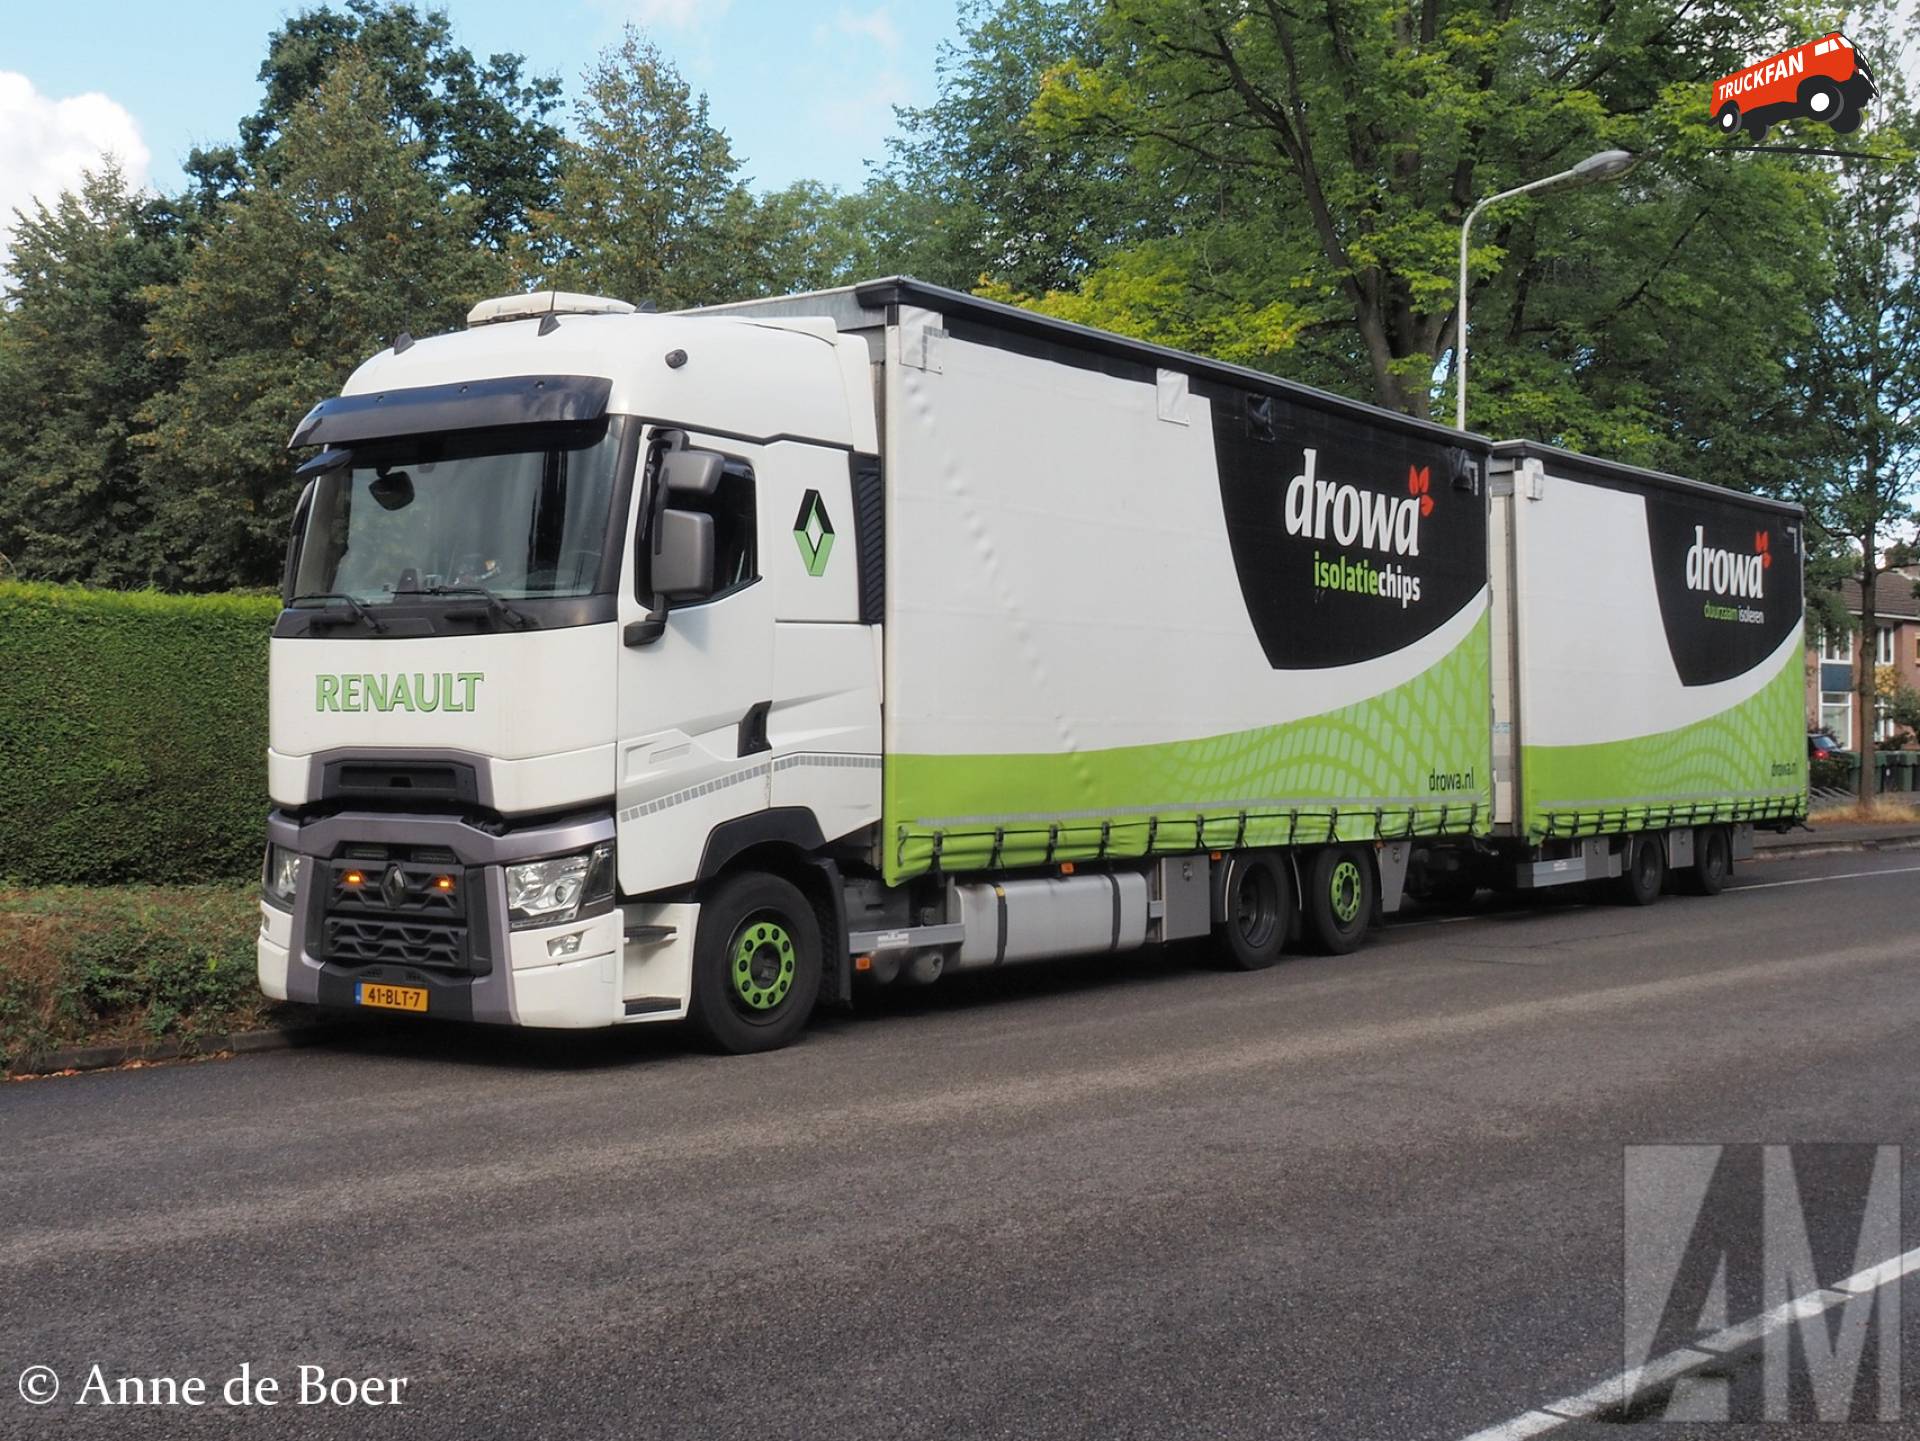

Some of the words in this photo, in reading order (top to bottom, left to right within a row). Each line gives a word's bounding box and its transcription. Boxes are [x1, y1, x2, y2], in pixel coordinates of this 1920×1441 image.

[1284, 447, 1420, 557] drowa
[1314, 550, 1421, 609] isolatiechips
[1686, 525, 1764, 599] drowa
[315, 672, 485, 713] RENAULT
[1428, 766, 1474, 792] drowa.nl
[367, 986, 422, 1008] 41-BLT-7
